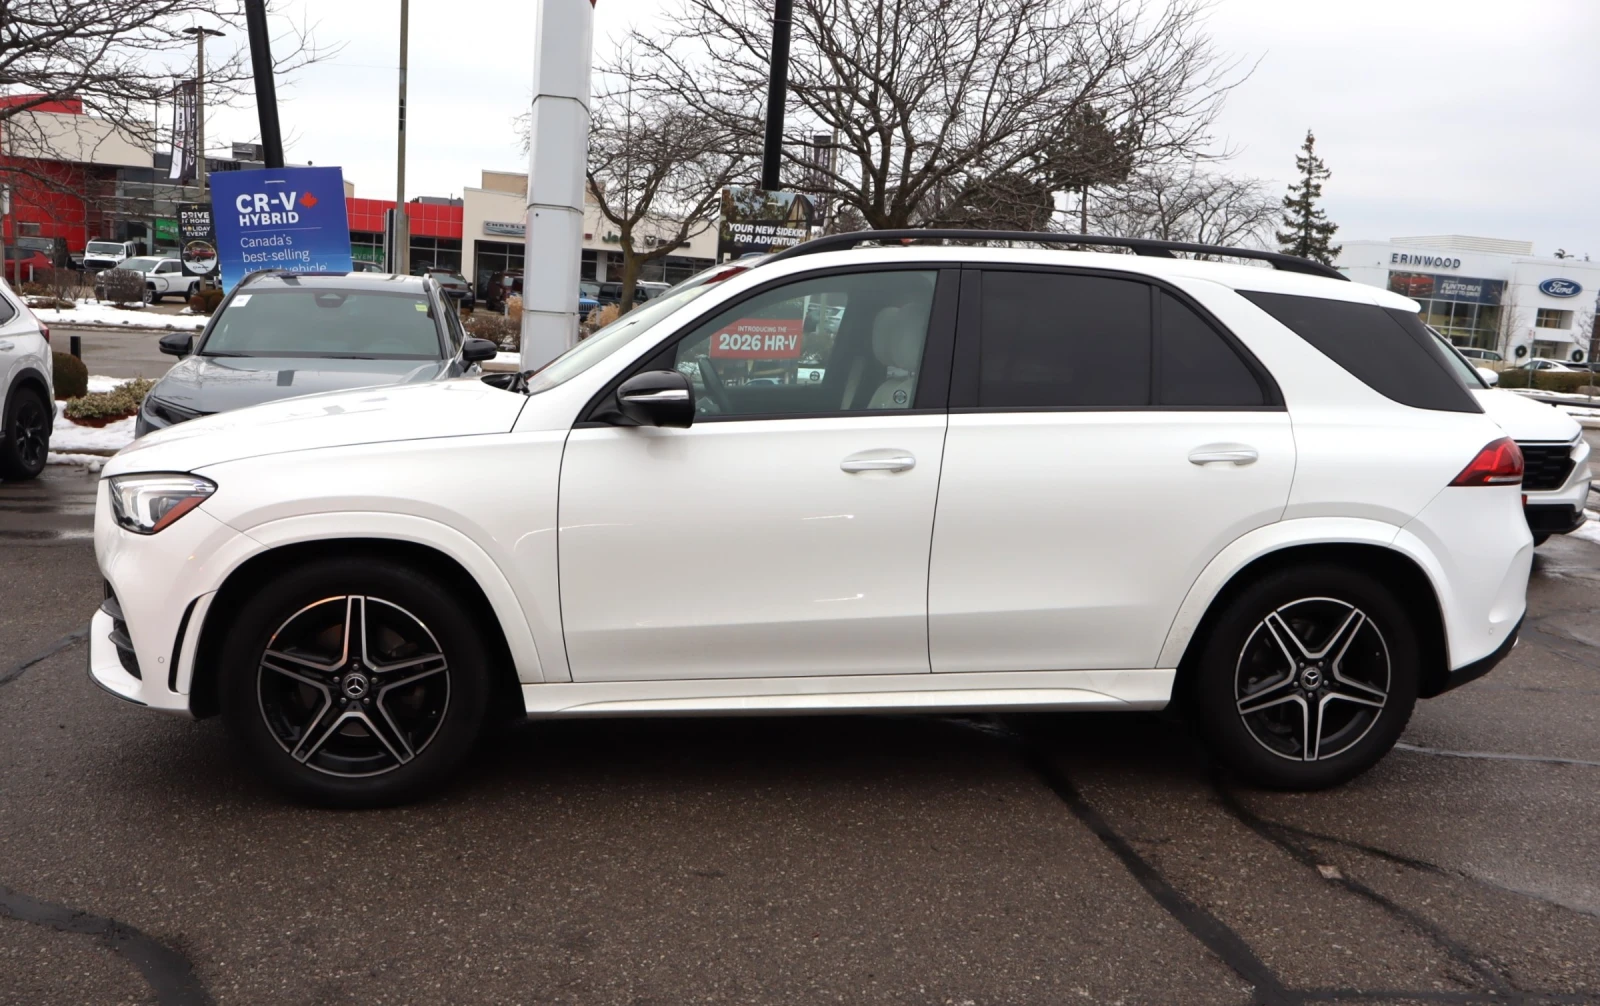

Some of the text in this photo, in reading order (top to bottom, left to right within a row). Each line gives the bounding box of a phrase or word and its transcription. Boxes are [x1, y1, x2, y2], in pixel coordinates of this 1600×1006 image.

[236, 192, 297, 213] CR-V
[181, 211, 210, 219] DRIVE
[239, 212, 299, 226] HYBRID
[486, 222, 526, 230] CHRYSLE
[728, 222, 808, 237] YOUR NEW SIDEKICK
[240, 234, 293, 248] Canada's
[734, 234, 801, 246] FOR ADVENTURE
[242, 248, 311, 263] best-selling
[1391, 253, 1461, 269] ERINWOOD
[1549, 281, 1575, 294] Ford
[737, 325, 777, 333] INTRODUCING
[719, 333, 798, 351] 2026 HR-V
